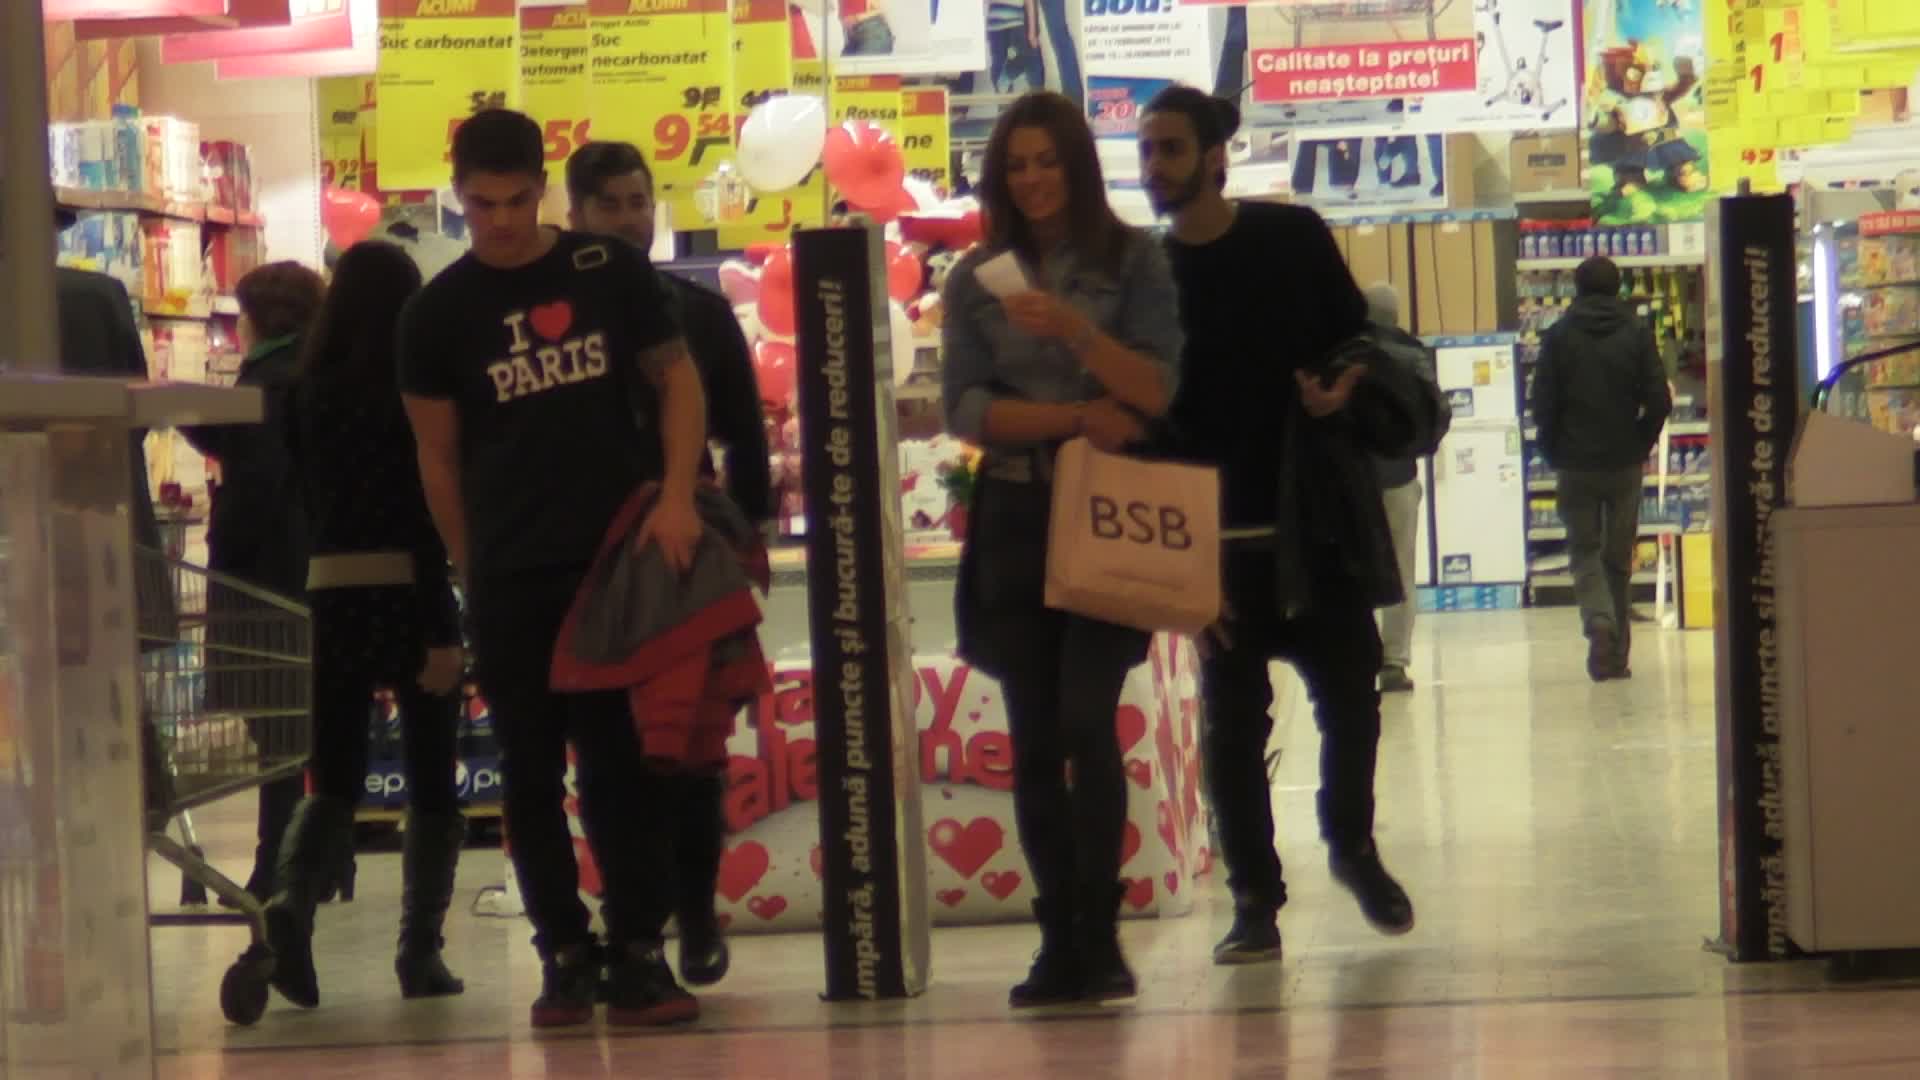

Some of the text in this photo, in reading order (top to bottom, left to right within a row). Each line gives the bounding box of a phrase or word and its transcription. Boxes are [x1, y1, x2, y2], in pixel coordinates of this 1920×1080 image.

[414, 34, 513, 50] carbonatat
[592, 34, 622, 48] Suc
[592, 51, 708, 67] necarbonatat
[1256, 52, 1351, 73] Calitate
[1358, 49, 1381, 67] la
[653, 112, 690, 161] 9
[503, 312, 531, 353] I
[1743, 247, 1770, 386] reduceri!
[487, 333, 606, 402] PARIS
[818, 279, 849, 418] reduceri!
[1747, 395, 1774, 432] de
[824, 427, 853, 465] de
[1090, 495, 1192, 552] BSB
[830, 474, 860, 623] bucură-te
[835, 661, 872, 769] puncte
[840, 777, 871, 873] adună
